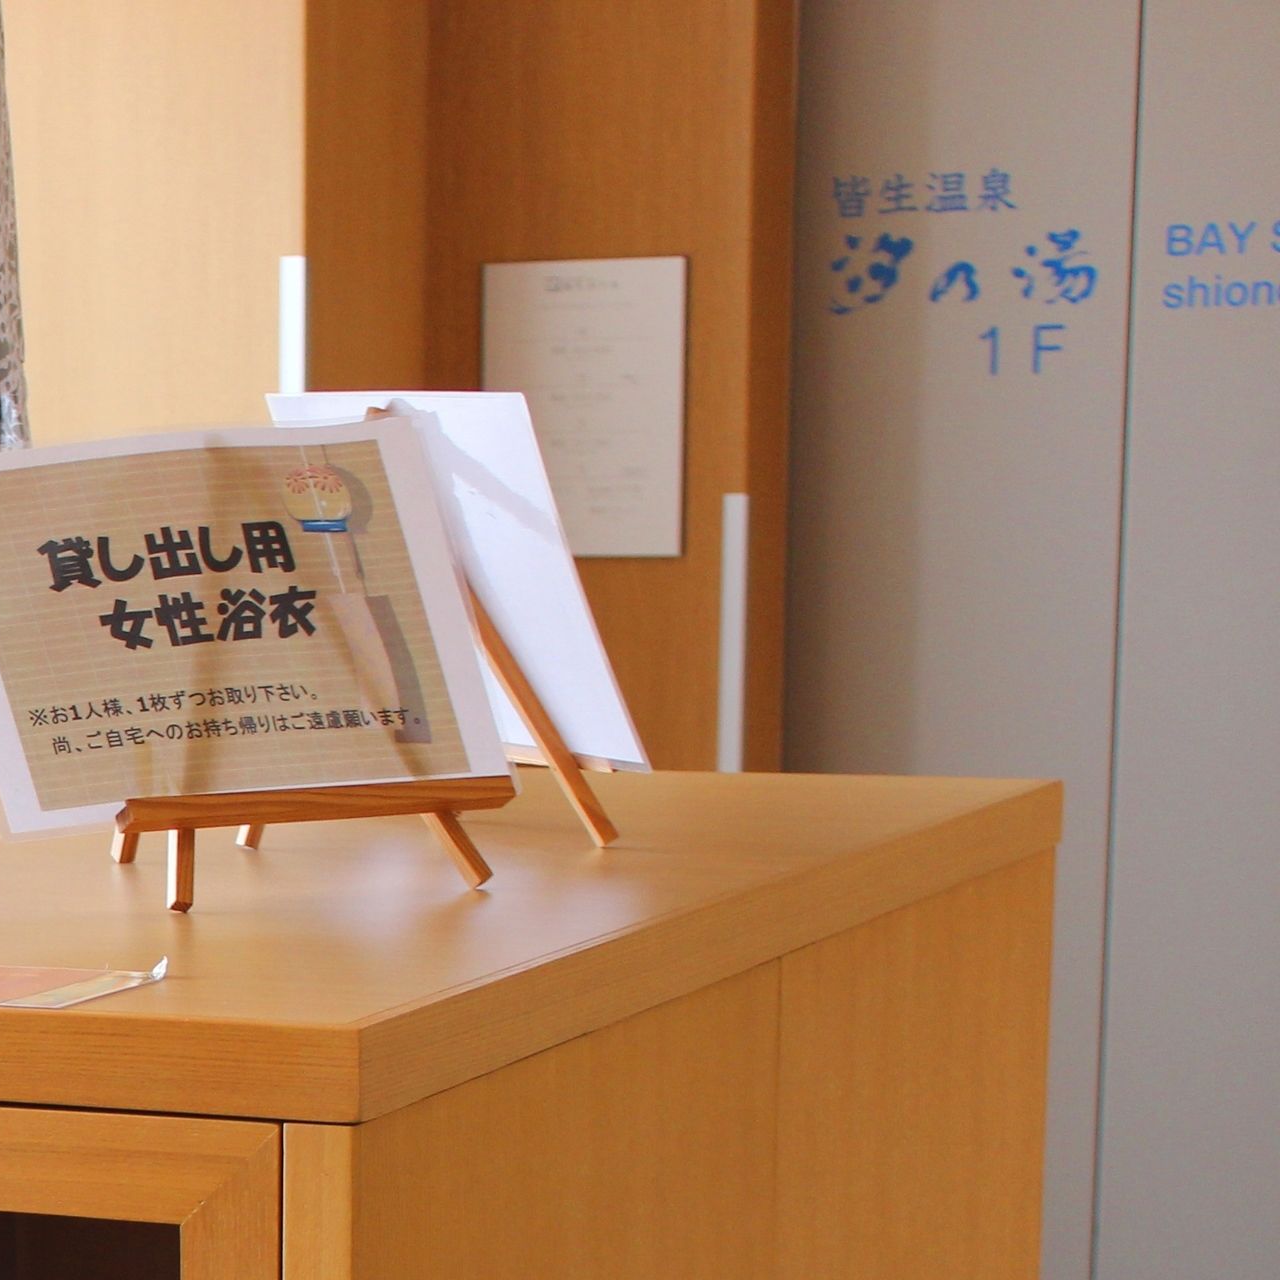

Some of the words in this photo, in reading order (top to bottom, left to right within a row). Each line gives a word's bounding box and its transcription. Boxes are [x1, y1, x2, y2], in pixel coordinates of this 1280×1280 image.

[832, 167, 1018, 219] 皆生温泉
[1166, 221, 1258, 257] BAY
[1163, 274, 1280, 309] shion
[36, 519, 297, 593] 貸し出し用
[98, 584, 318, 651] 女性浴衣
[51, 707, 422, 755] 尚、ご自宅へのお持ち帰りはご遠慮願います。
